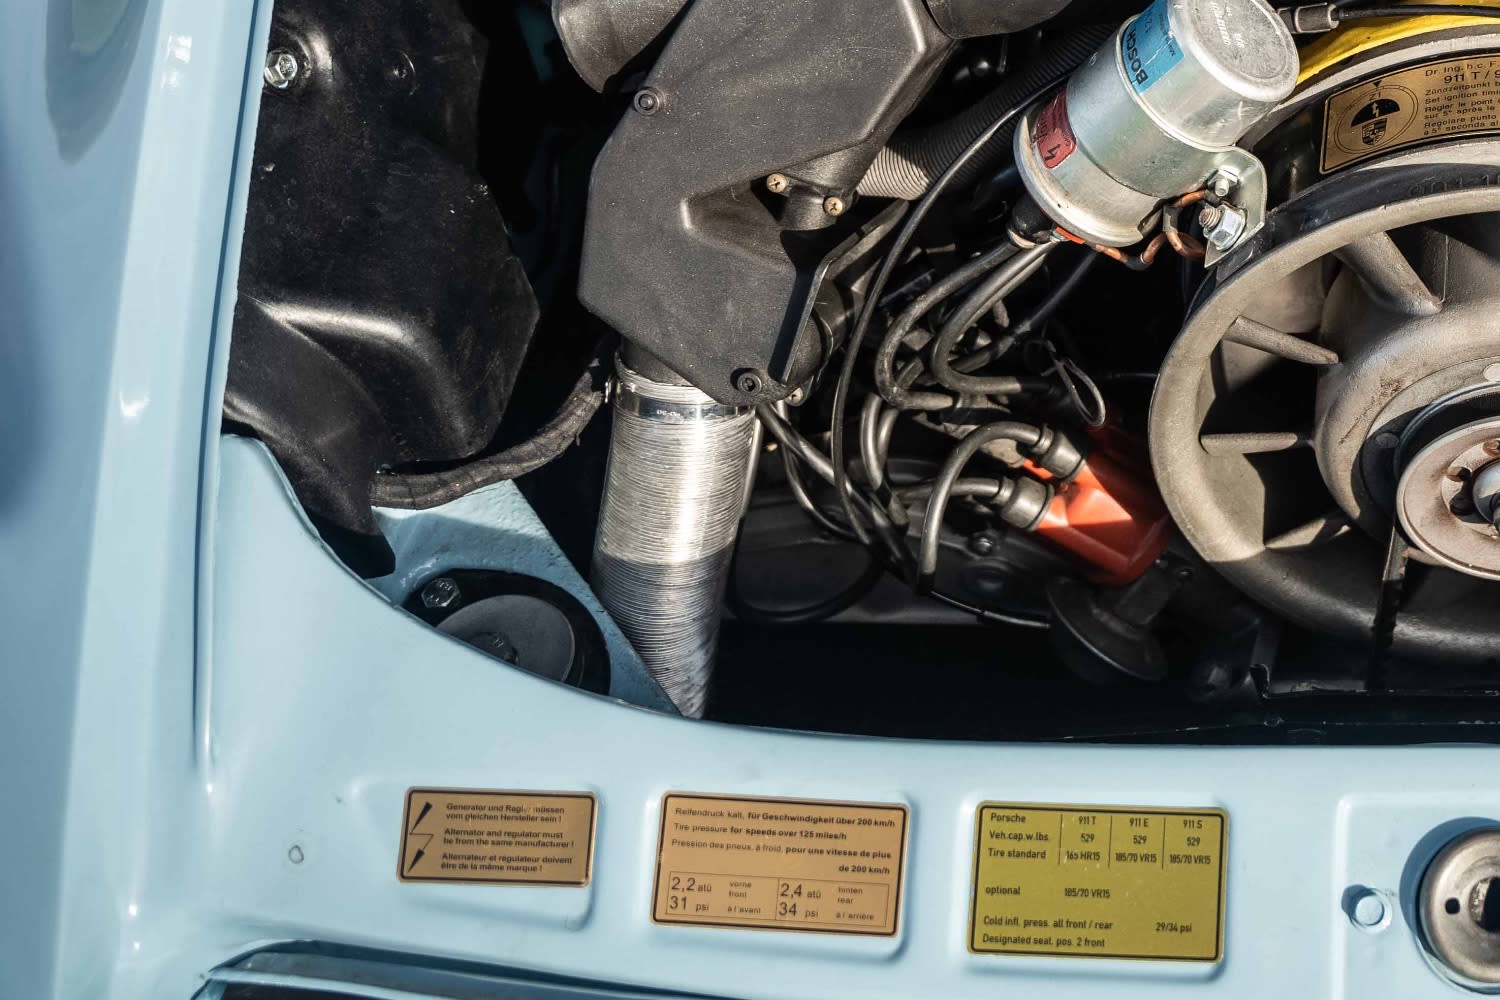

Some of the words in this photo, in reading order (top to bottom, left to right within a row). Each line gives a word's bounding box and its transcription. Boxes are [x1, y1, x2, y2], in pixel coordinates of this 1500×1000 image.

[1444, 74, 1464, 83] 911
[1472, 72, 1480, 80] T
[857, 818, 872, 826] 200
[873, 819, 895, 828] km/h
[990, 813, 1026, 823] Porsche
[1078, 815, 1090, 824] 911
[1129, 818, 1141, 827] 911
[1182, 819, 1195, 828] 911
[673, 823, 689, 831] Tire
[692, 825, 727, 834] pressure
[730, 826, 742, 834] for
[745, 827, 776, 837] speeds
[778, 829, 797, 837] over
[1080, 833, 1094, 842] 529
[1132, 835, 1147, 844] 529
[1186, 837, 1200, 846] 529
[785, 846, 806, 855] pour
[987, 848, 1005, 857] Tire
[1007, 848, 1046, 858] standard
[838, 864, 849, 872] de
[851, 865, 866, 873] 200
[868, 866, 890, 874] km/h
[670, 876, 696, 893] 2,2
[779, 882, 803, 899] 2,4
[985, 885, 1021, 896] optional
[668, 896, 687, 910] 31
[778, 902, 797, 916] 34
[983, 915, 1003, 925] Cold
[1053, 918, 1064, 927] all
[1066, 919, 1087, 928] front
[1094, 921, 1112, 929] rear
[982, 933, 1031, 945] Designated
[1083, 937, 1105, 947] front
